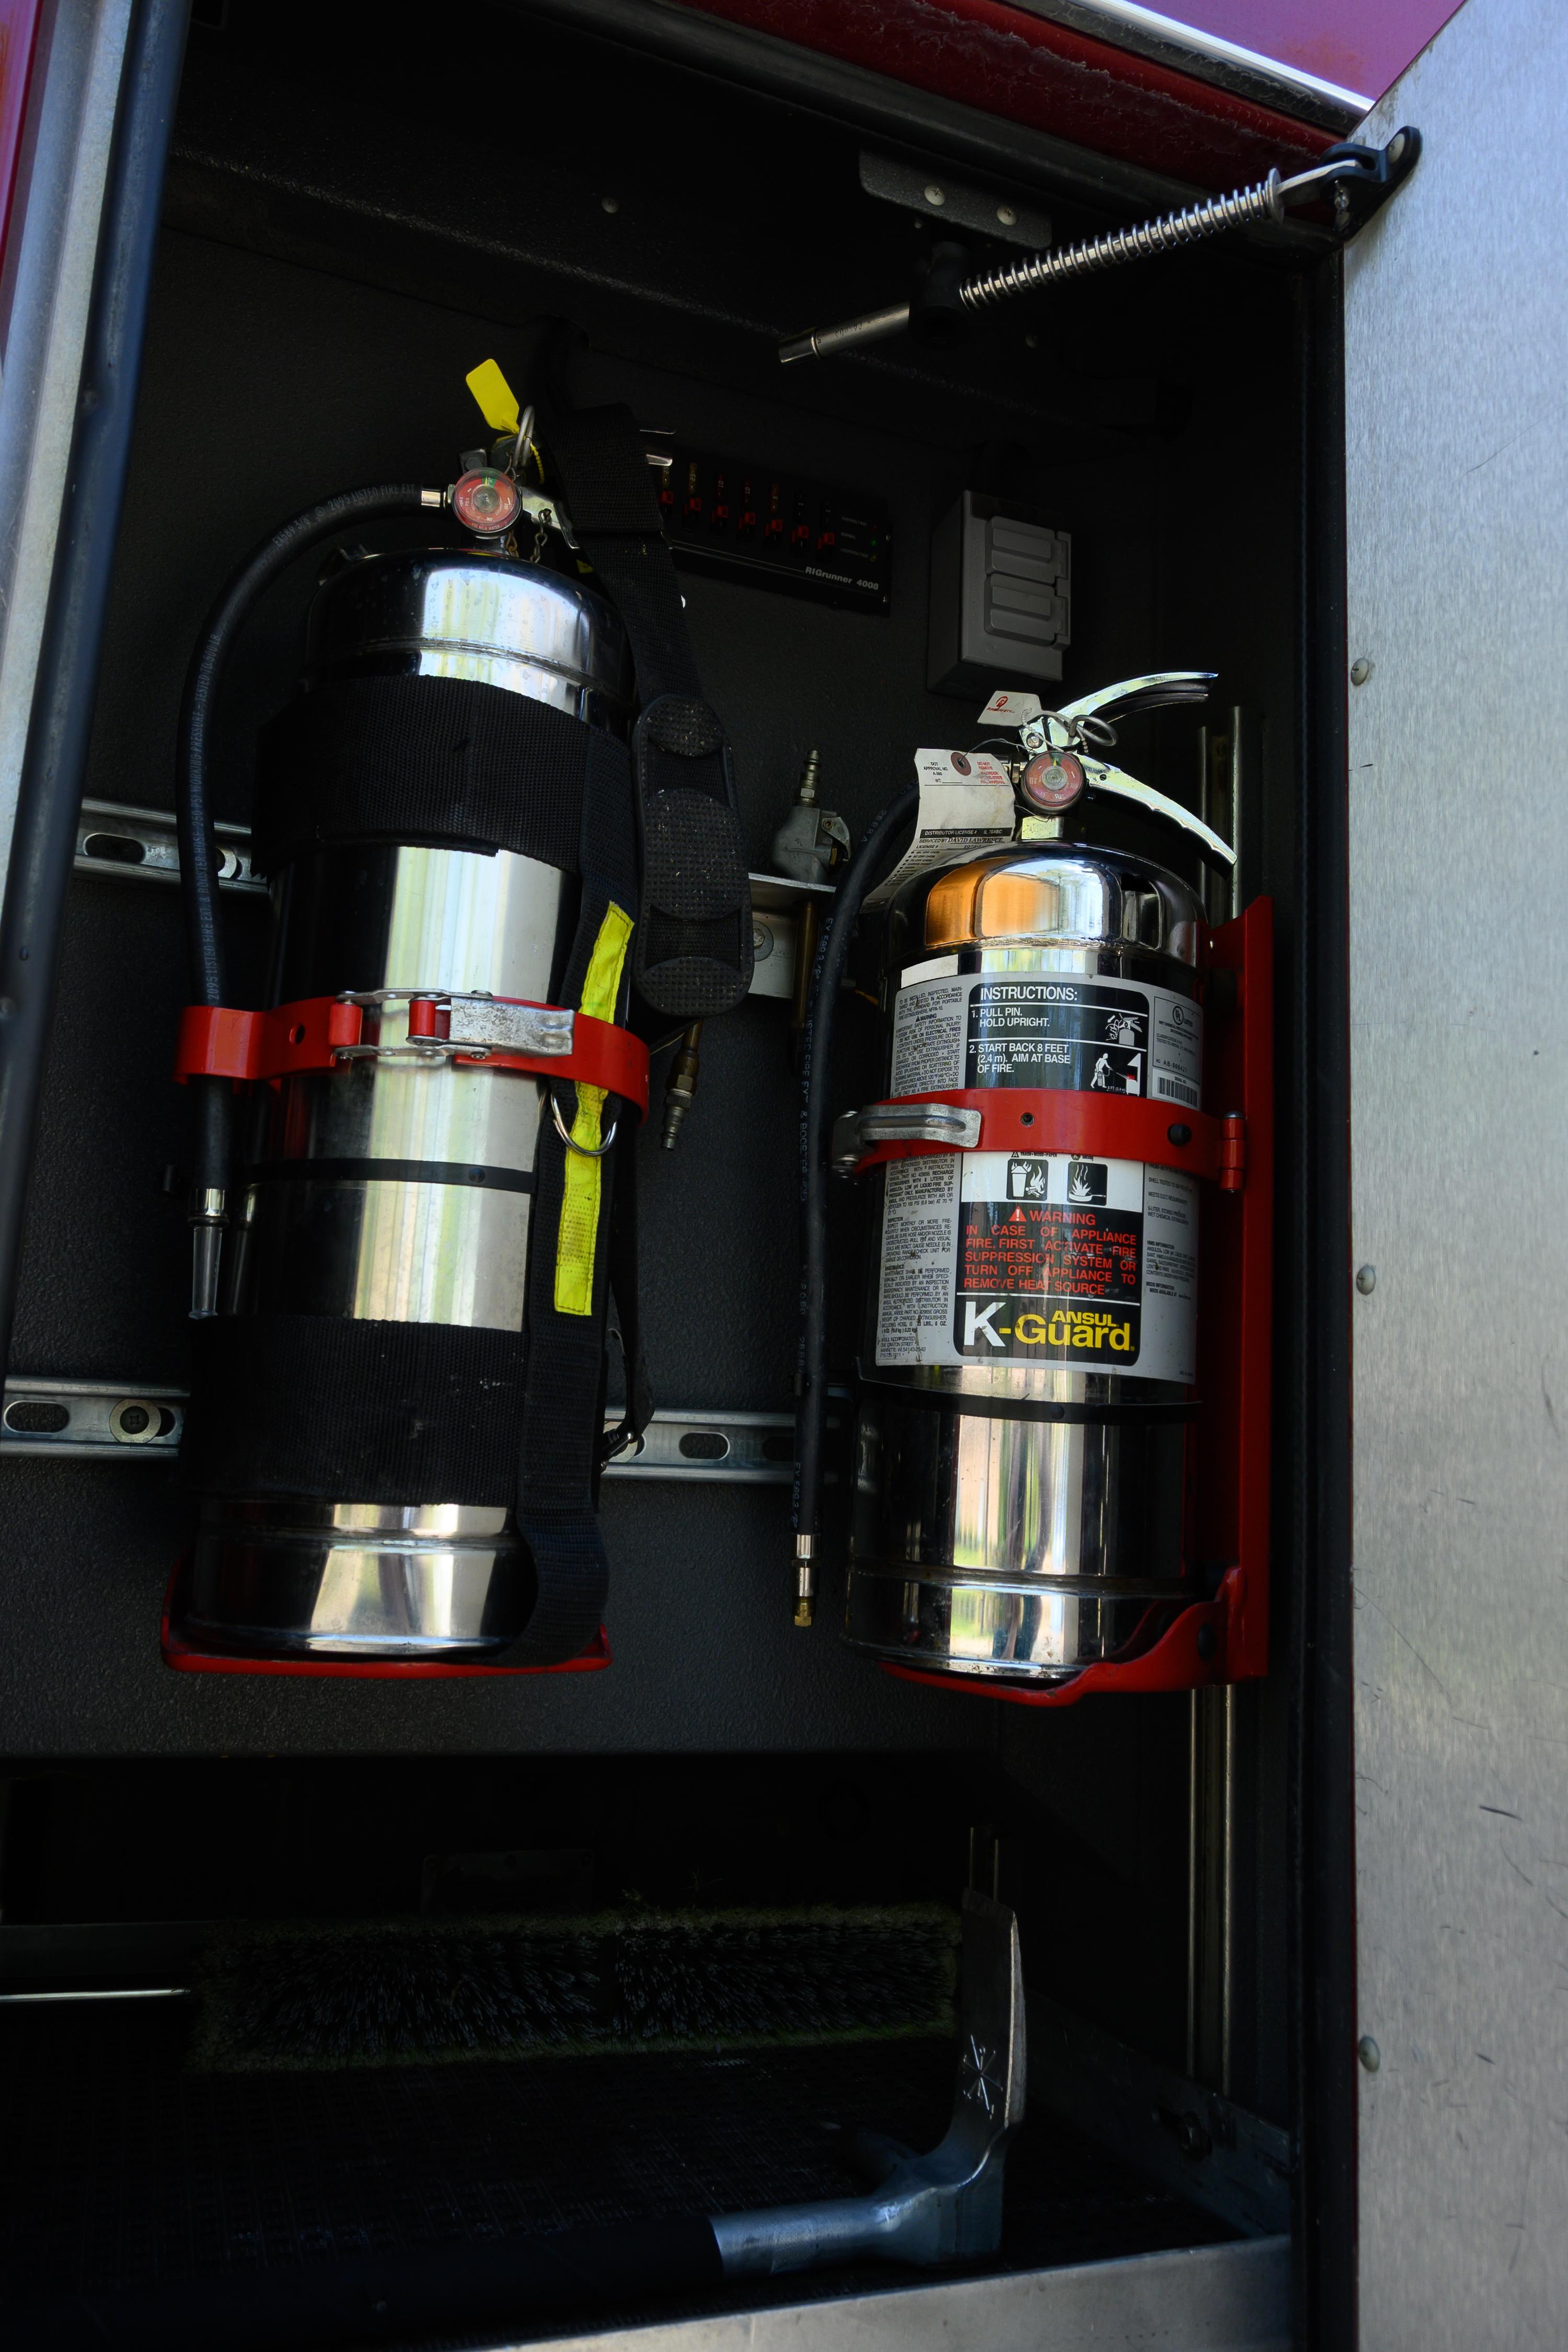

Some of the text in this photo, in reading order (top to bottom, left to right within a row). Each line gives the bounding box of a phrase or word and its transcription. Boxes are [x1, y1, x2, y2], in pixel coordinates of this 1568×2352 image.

[328, 494, 351, 511] 2095
[351, 487, 378, 502] LISTED
[380, 485, 399, 495] FIRE
[805, 566, 879, 591] RIGrunner 4008
[194, 674, 209, 701] TESTED
[190, 711, 204, 752] PRESSURE
[190, 751, 202, 793] WORKING
[202, 923, 214, 942] FIRE
[204, 945, 217, 974] LISTED
[980, 986, 1078, 1001] INSTRUCTIONS:
[980, 1008, 1003, 1017] PULL
[1005, 1007, 1022, 1016] PIN.
[979, 1017, 1050, 1028] HOLD UPRIGHT.
[926, 1044, 953, 1052] EXTINGUISHER
[978, 1043, 1008, 1053] START
[1009, 1043, 1036, 1052] BACK
[1037, 1043, 1043, 1052] 8
[1045, 1044, 1069, 1054] FEET
[977, 1054, 1070, 1064] (2.4 m). AIM AT BASE
[977, 1064, 1014, 1074] OF FIRE.
[1029, 1209, 1096, 1226] WARNING
[966, 1225, 1137, 1246] IN CASE OF APPLIANCE
[965, 1238, 996, 1250] FIRE,
[999, 1238, 1035, 1250] FIRST
[1045, 1240, 1104, 1255] ACTIVATE
[1112, 1246, 1137, 1259] FIRE
[965, 1251, 1054, 1264] SUPPRESSION
[1063, 1254, 1113, 1270] SYSTEM
[1120, 1260, 1136, 1272] OR
[965, 1264, 1136, 1285] TURN OFF APPLIANCE TO
[963, 1277, 1105, 1296] REMOVE HEAT SOURCE
[1052, 1310, 1117, 1328] ANSUL
